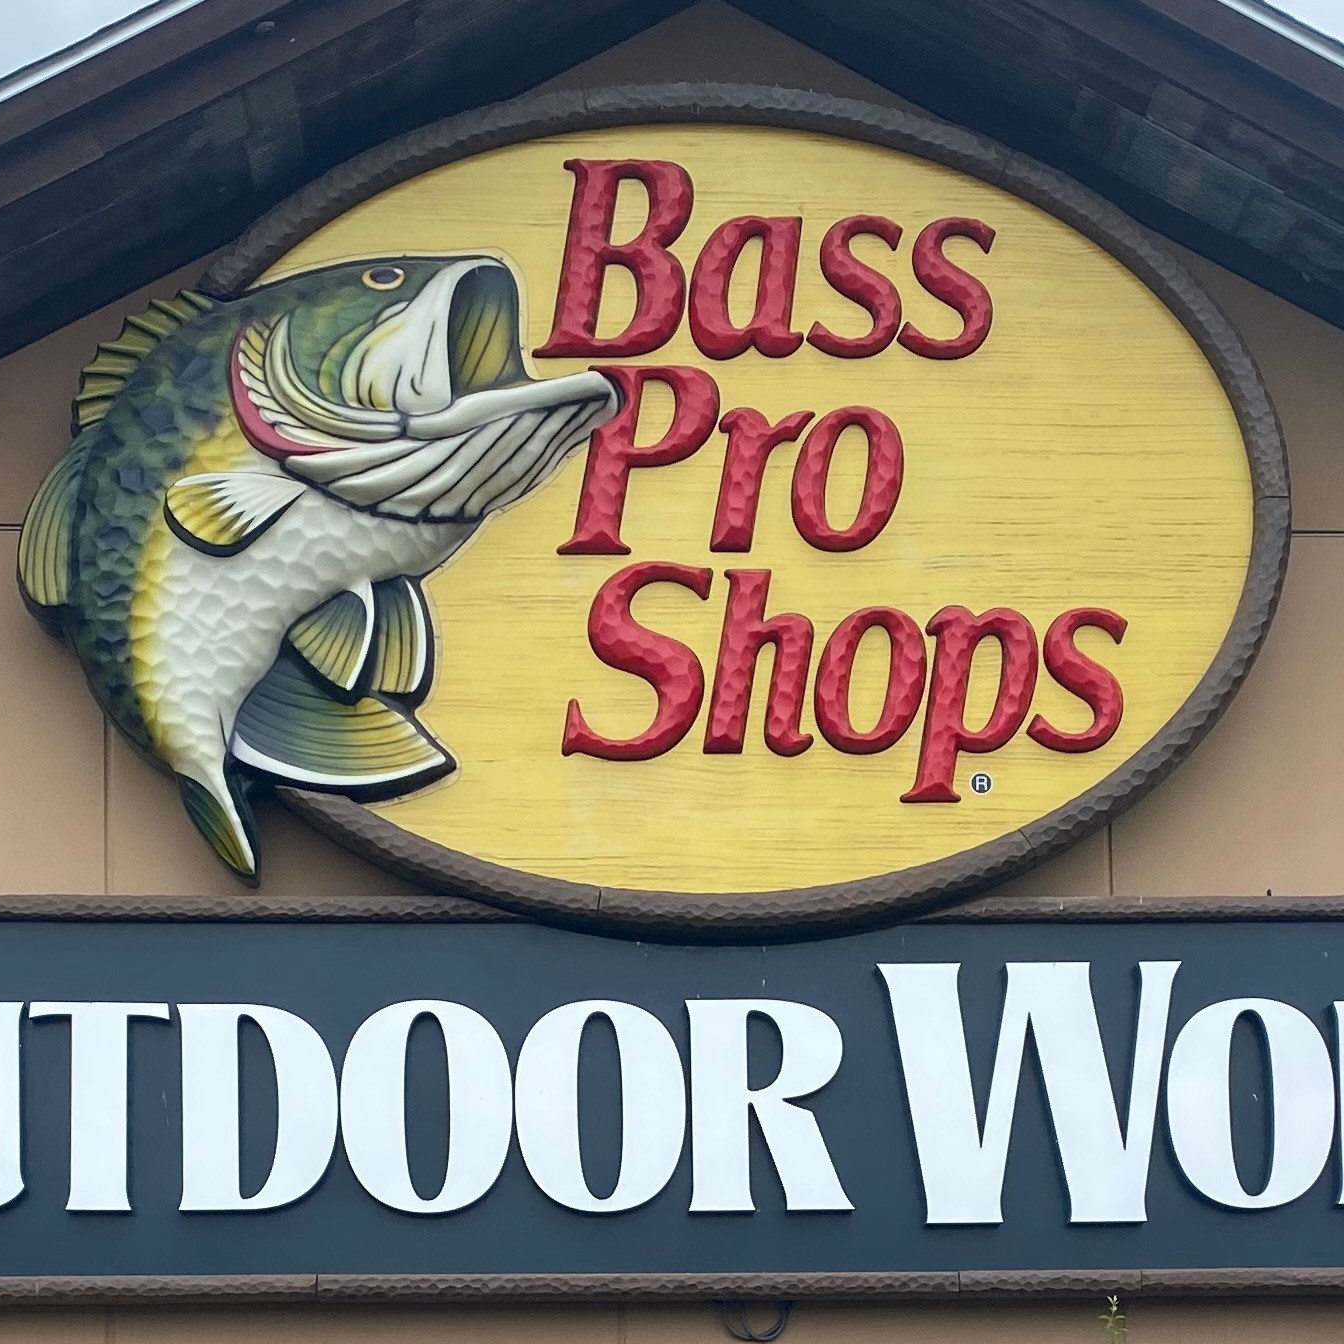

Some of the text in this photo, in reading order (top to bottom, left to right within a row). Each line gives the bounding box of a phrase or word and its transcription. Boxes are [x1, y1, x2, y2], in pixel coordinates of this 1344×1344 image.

[532, 158, 996, 361] Bass
[556, 365, 904, 555] Pro
[562, 560, 1128, 803] Shops
